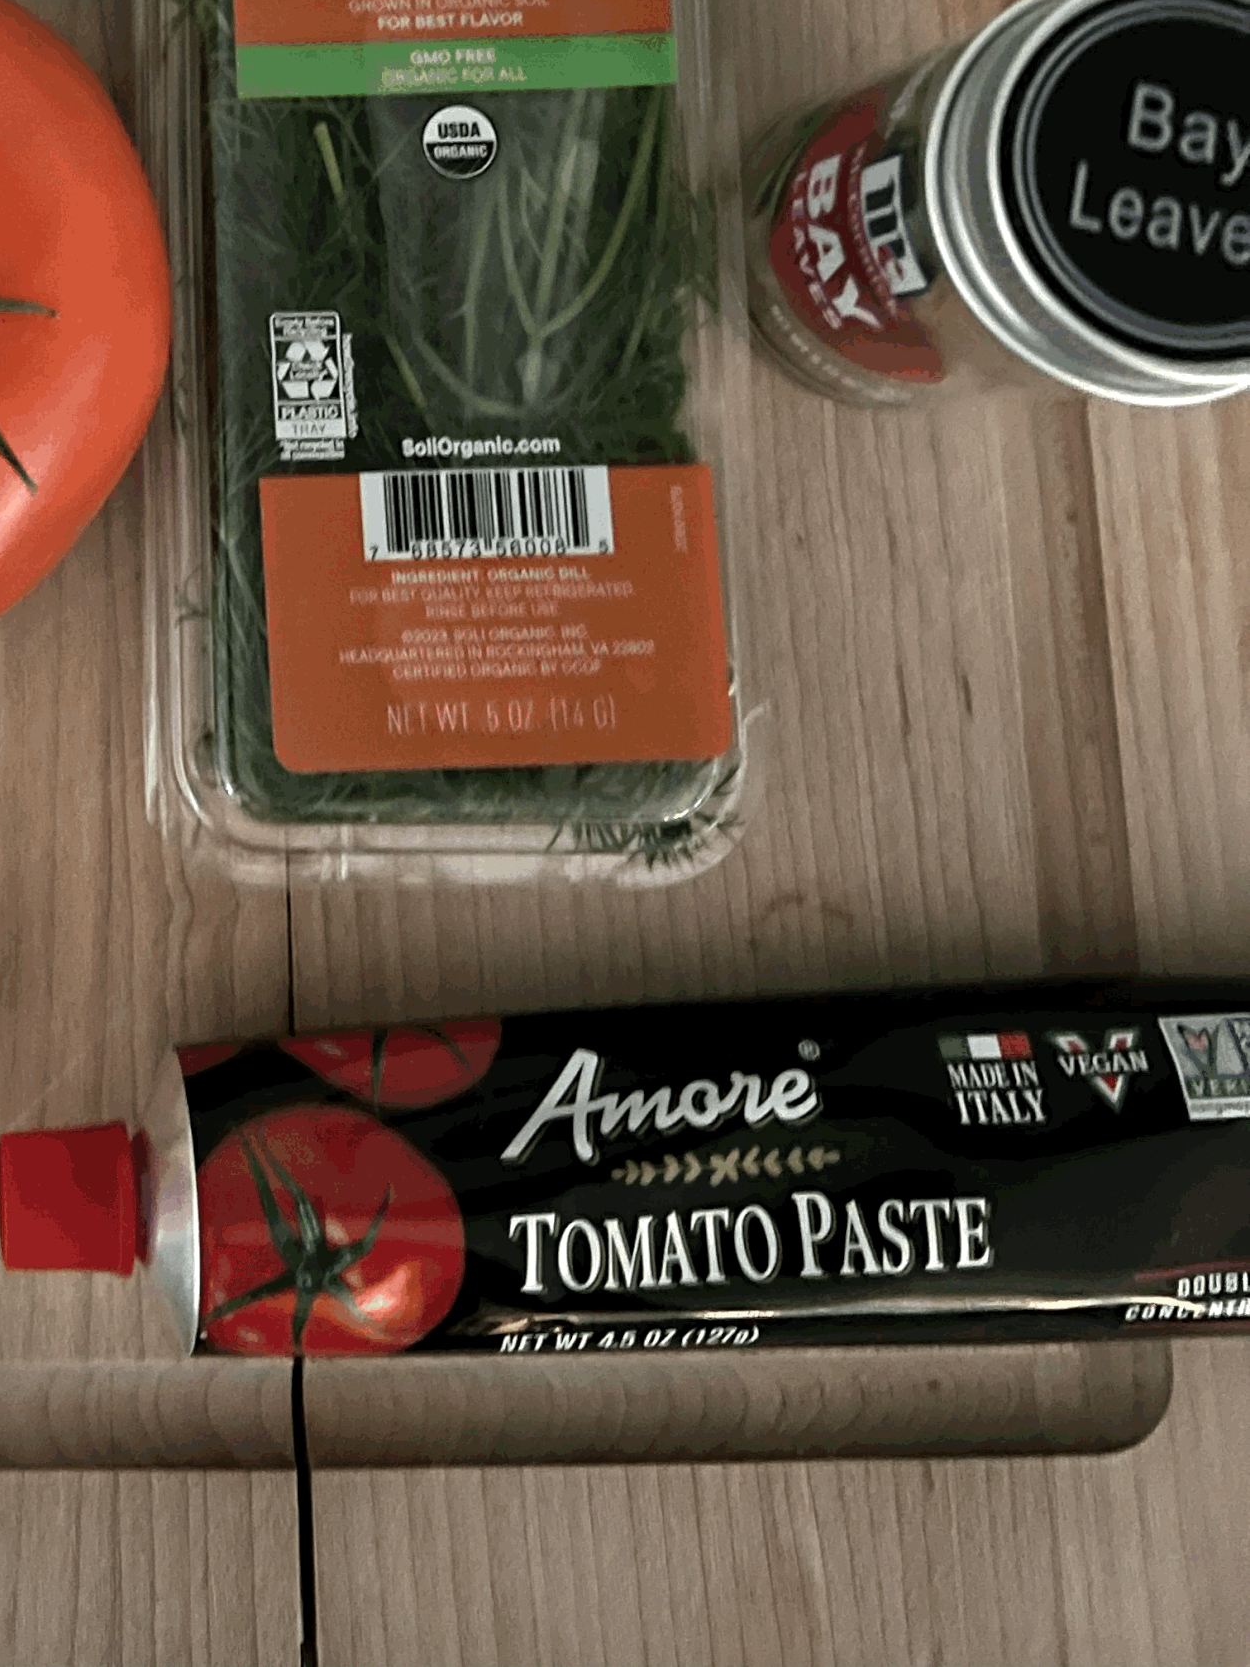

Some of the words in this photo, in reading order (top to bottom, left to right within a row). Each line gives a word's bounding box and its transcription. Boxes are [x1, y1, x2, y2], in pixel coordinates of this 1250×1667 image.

[377, 14, 411, 31] FOR
[415, 12, 456, 29] BEST
[460, 10, 524, 28] FLAVOR
[409, 48, 452, 66] GMO
[454, 46, 497, 64] FREE
[437, 120, 481, 140] USDA
[1127, 82, 1250, 186] Bay
[433, 144, 488, 160] ORGANIC
[806, 153, 884, 332] BAY
[368, 544, 380, 562] 7
[487, 565, 555, 583] ORGANIC
[387, 700, 427, 735] NET
[434, 699, 470, 733] WT
[947, 1061, 1011, 1090] MADE
[1012, 1059, 1041, 1087] IN
[1057, 1050, 1149, 1077] VEGAN
[499, 1046, 820, 1163] Amore
[955, 1088, 1048, 1127] ITALY
[509, 1203, 782, 1296] TOMATO
[791, 1190, 994, 1279] PASTE
[499, 1332, 549, 1353] NET
[553, 1331, 595, 1351] WT
[642, 1327, 678, 1348] OZ
